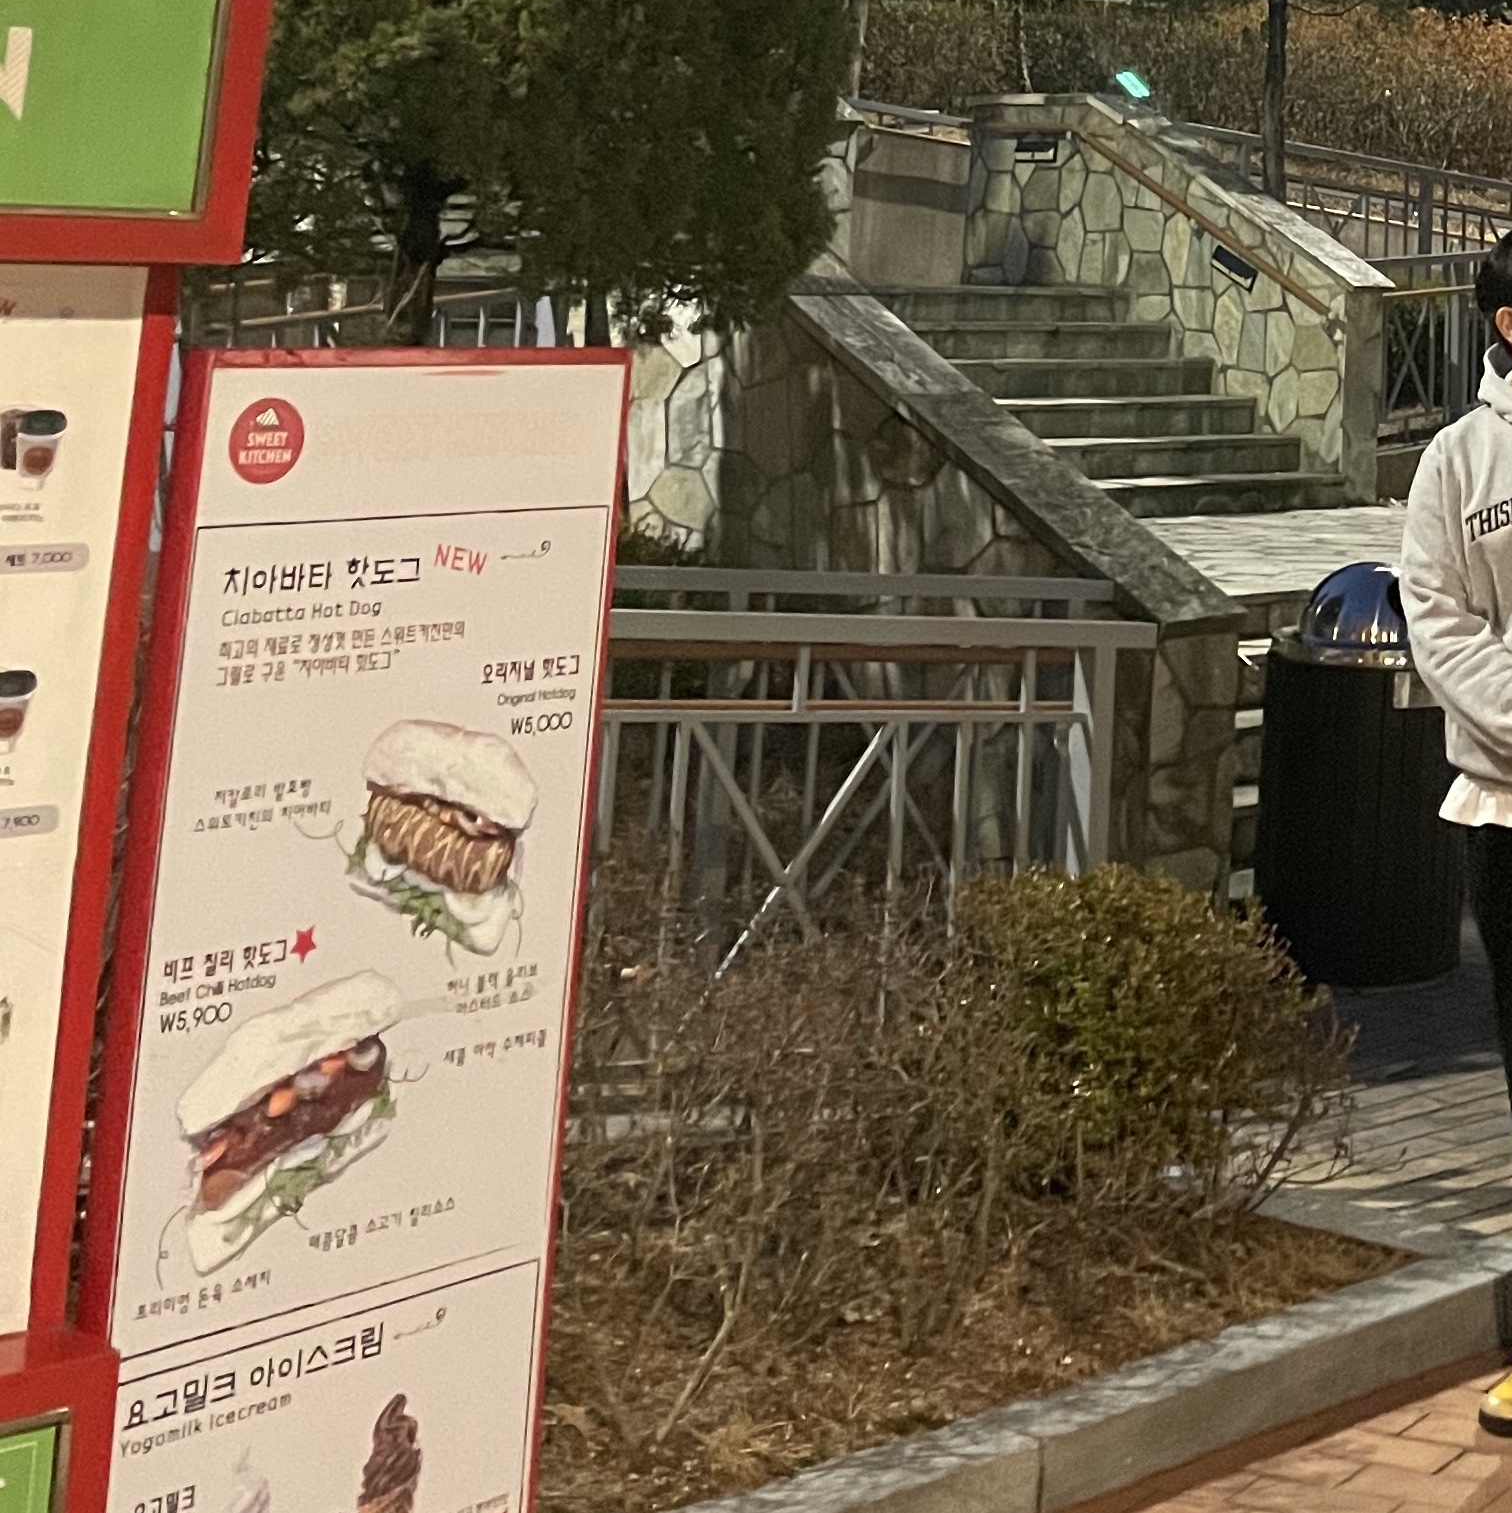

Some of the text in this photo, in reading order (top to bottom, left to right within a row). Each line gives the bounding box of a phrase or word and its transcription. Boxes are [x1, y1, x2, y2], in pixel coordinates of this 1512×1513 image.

[246, 432, 288, 447] SWEET
[238, 449, 293, 465] KITCHEN
[223, 543, 488, 596] 치아바타 핫도그 NEW
[221, 600, 382, 627] Ciabatta Hot Dog
[219, 638, 259, 660] 최고의
[264, 634, 303, 657] 재료로
[352, 628, 375, 649] 만든
[216, 664, 256, 686] 그릴로
[261, 660, 286, 682] 구운
[481, 654, 580, 684] 오리지널 핫도그
[163, 939, 287, 984] 비프 칠리 핫도그
[159, 987, 191, 1006] Beef
[228, 974, 277, 993] Hotdog
[121, 1321, 384, 1431] 요고밀크 아이스크림
[119, 1418, 203, 1459] Yogomilk
